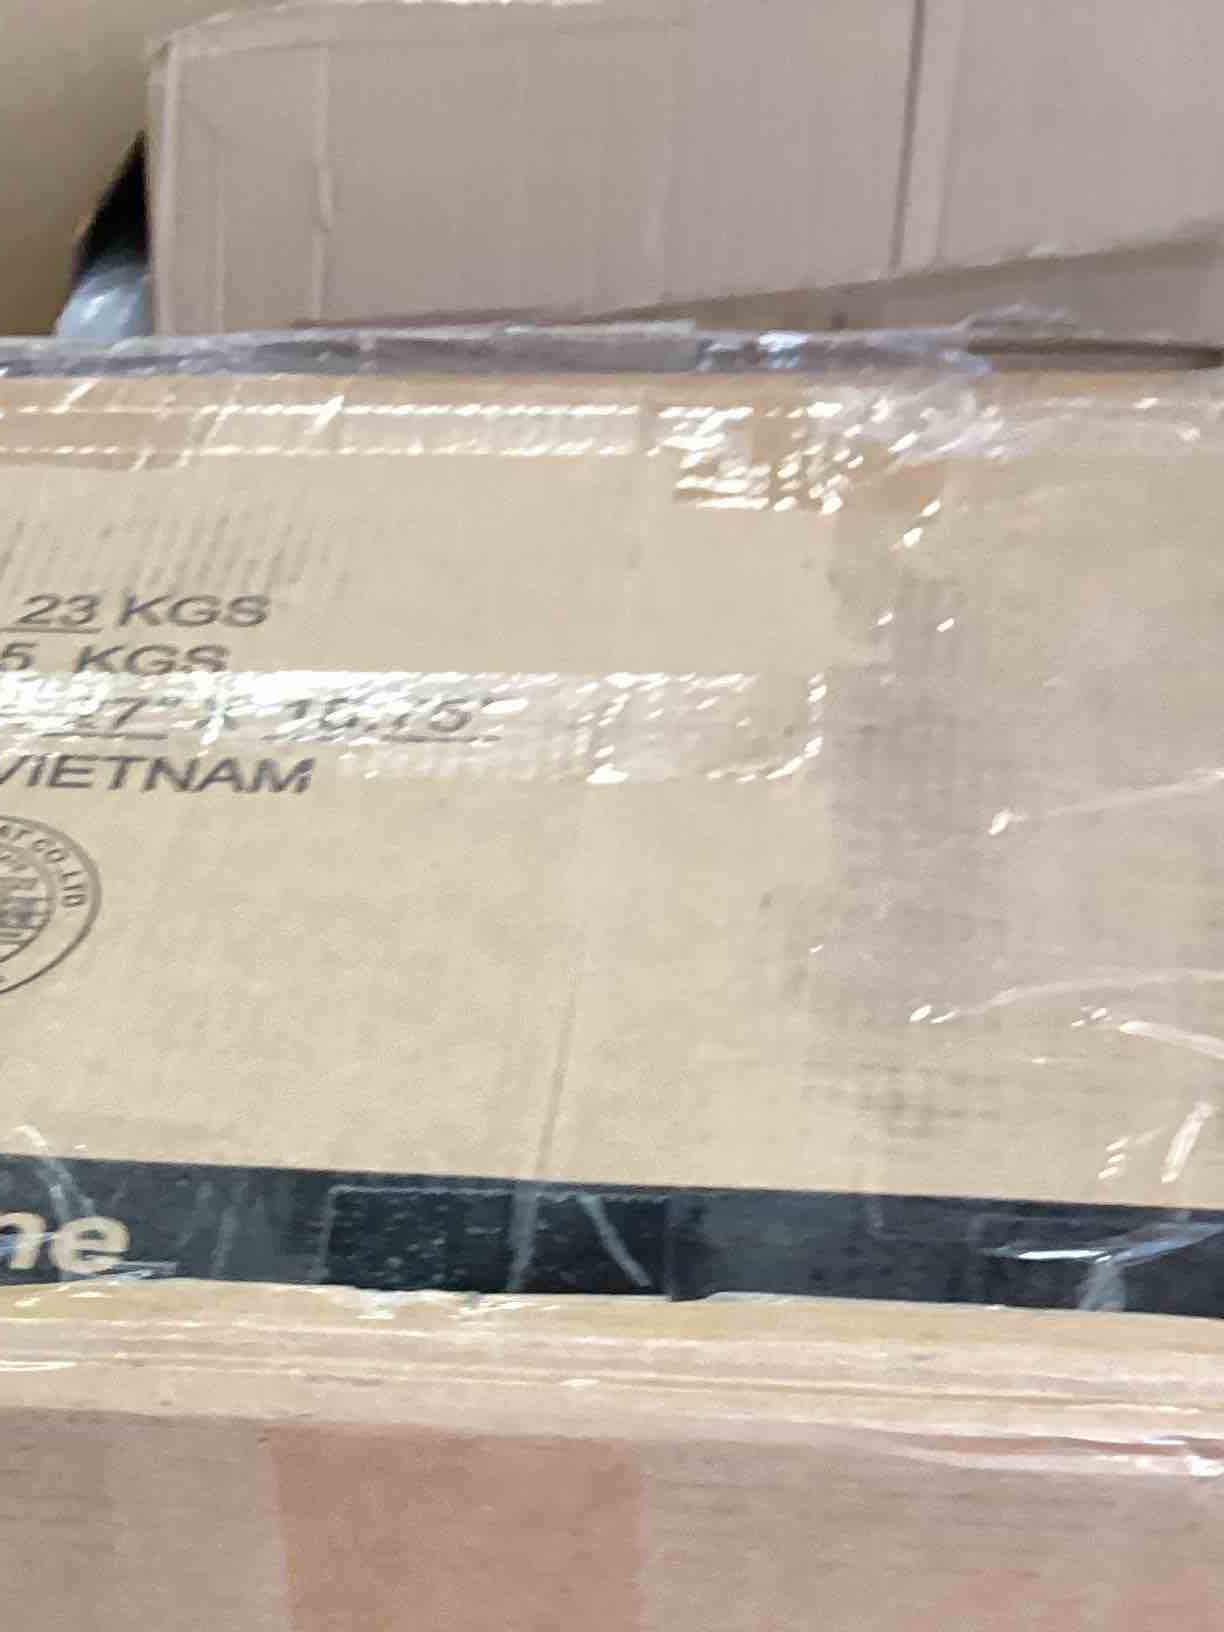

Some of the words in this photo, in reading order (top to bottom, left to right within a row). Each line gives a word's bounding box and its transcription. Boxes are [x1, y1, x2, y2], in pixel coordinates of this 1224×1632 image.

[10, 593, 102, 632] 23
[117, 592, 271, 628] KGS
[72, 642, 231, 676] KGS
